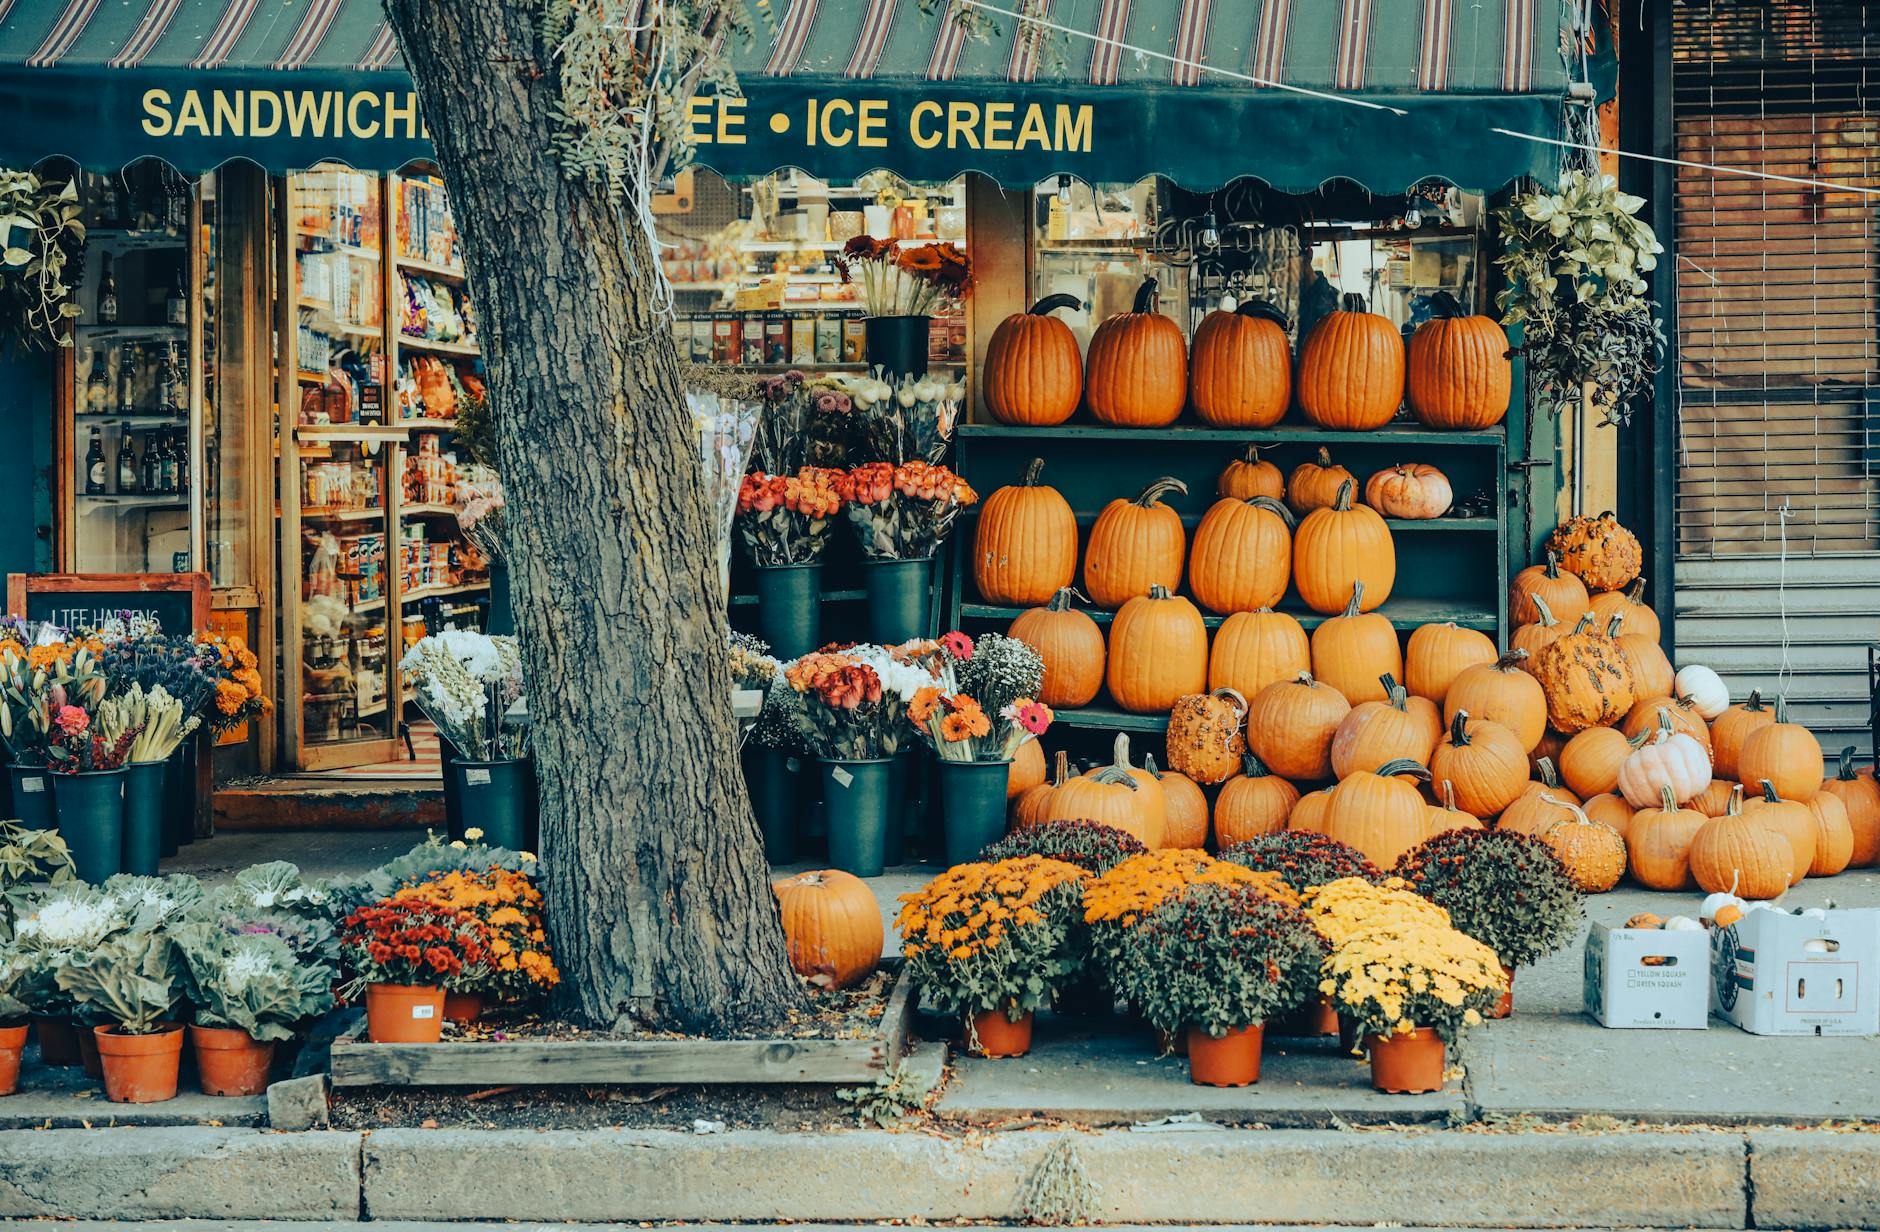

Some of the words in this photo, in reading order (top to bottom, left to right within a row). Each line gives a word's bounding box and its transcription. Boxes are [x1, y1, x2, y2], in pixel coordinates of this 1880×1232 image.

[141, 88, 430, 139] SANDWICH
[680, 96, 748, 144] EE
[806, 98, 889, 148] ICE
[909, 100, 1094, 153] CREAM
[1637, 970, 1660, 978] YELLOW
[1661, 970, 1687, 978] SQUASH
[1636, 979, 1656, 988] GREEN
[1657, 980, 1682, 988] SQUASH
